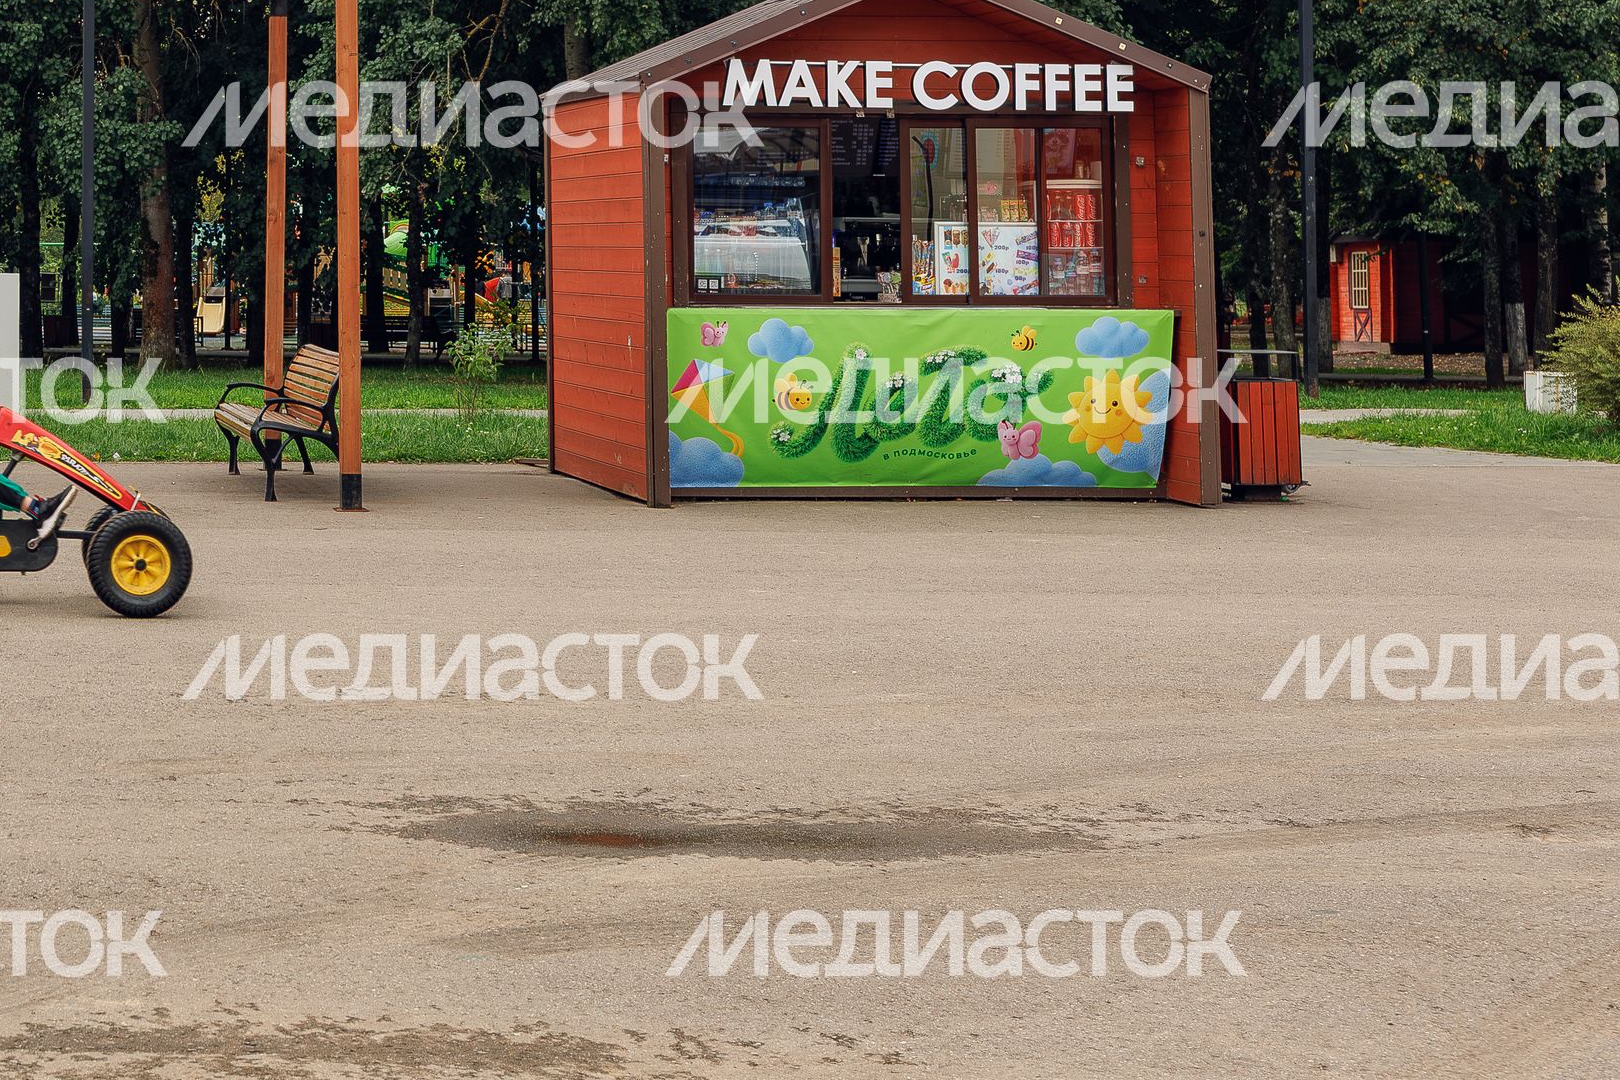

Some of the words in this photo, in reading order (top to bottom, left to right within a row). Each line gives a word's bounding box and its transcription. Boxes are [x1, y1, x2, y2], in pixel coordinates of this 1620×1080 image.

[722, 59, 893, 108] MAKE
[912, 61, 1135, 112] COFFEE
[768, 341, 1055, 464] Лето
